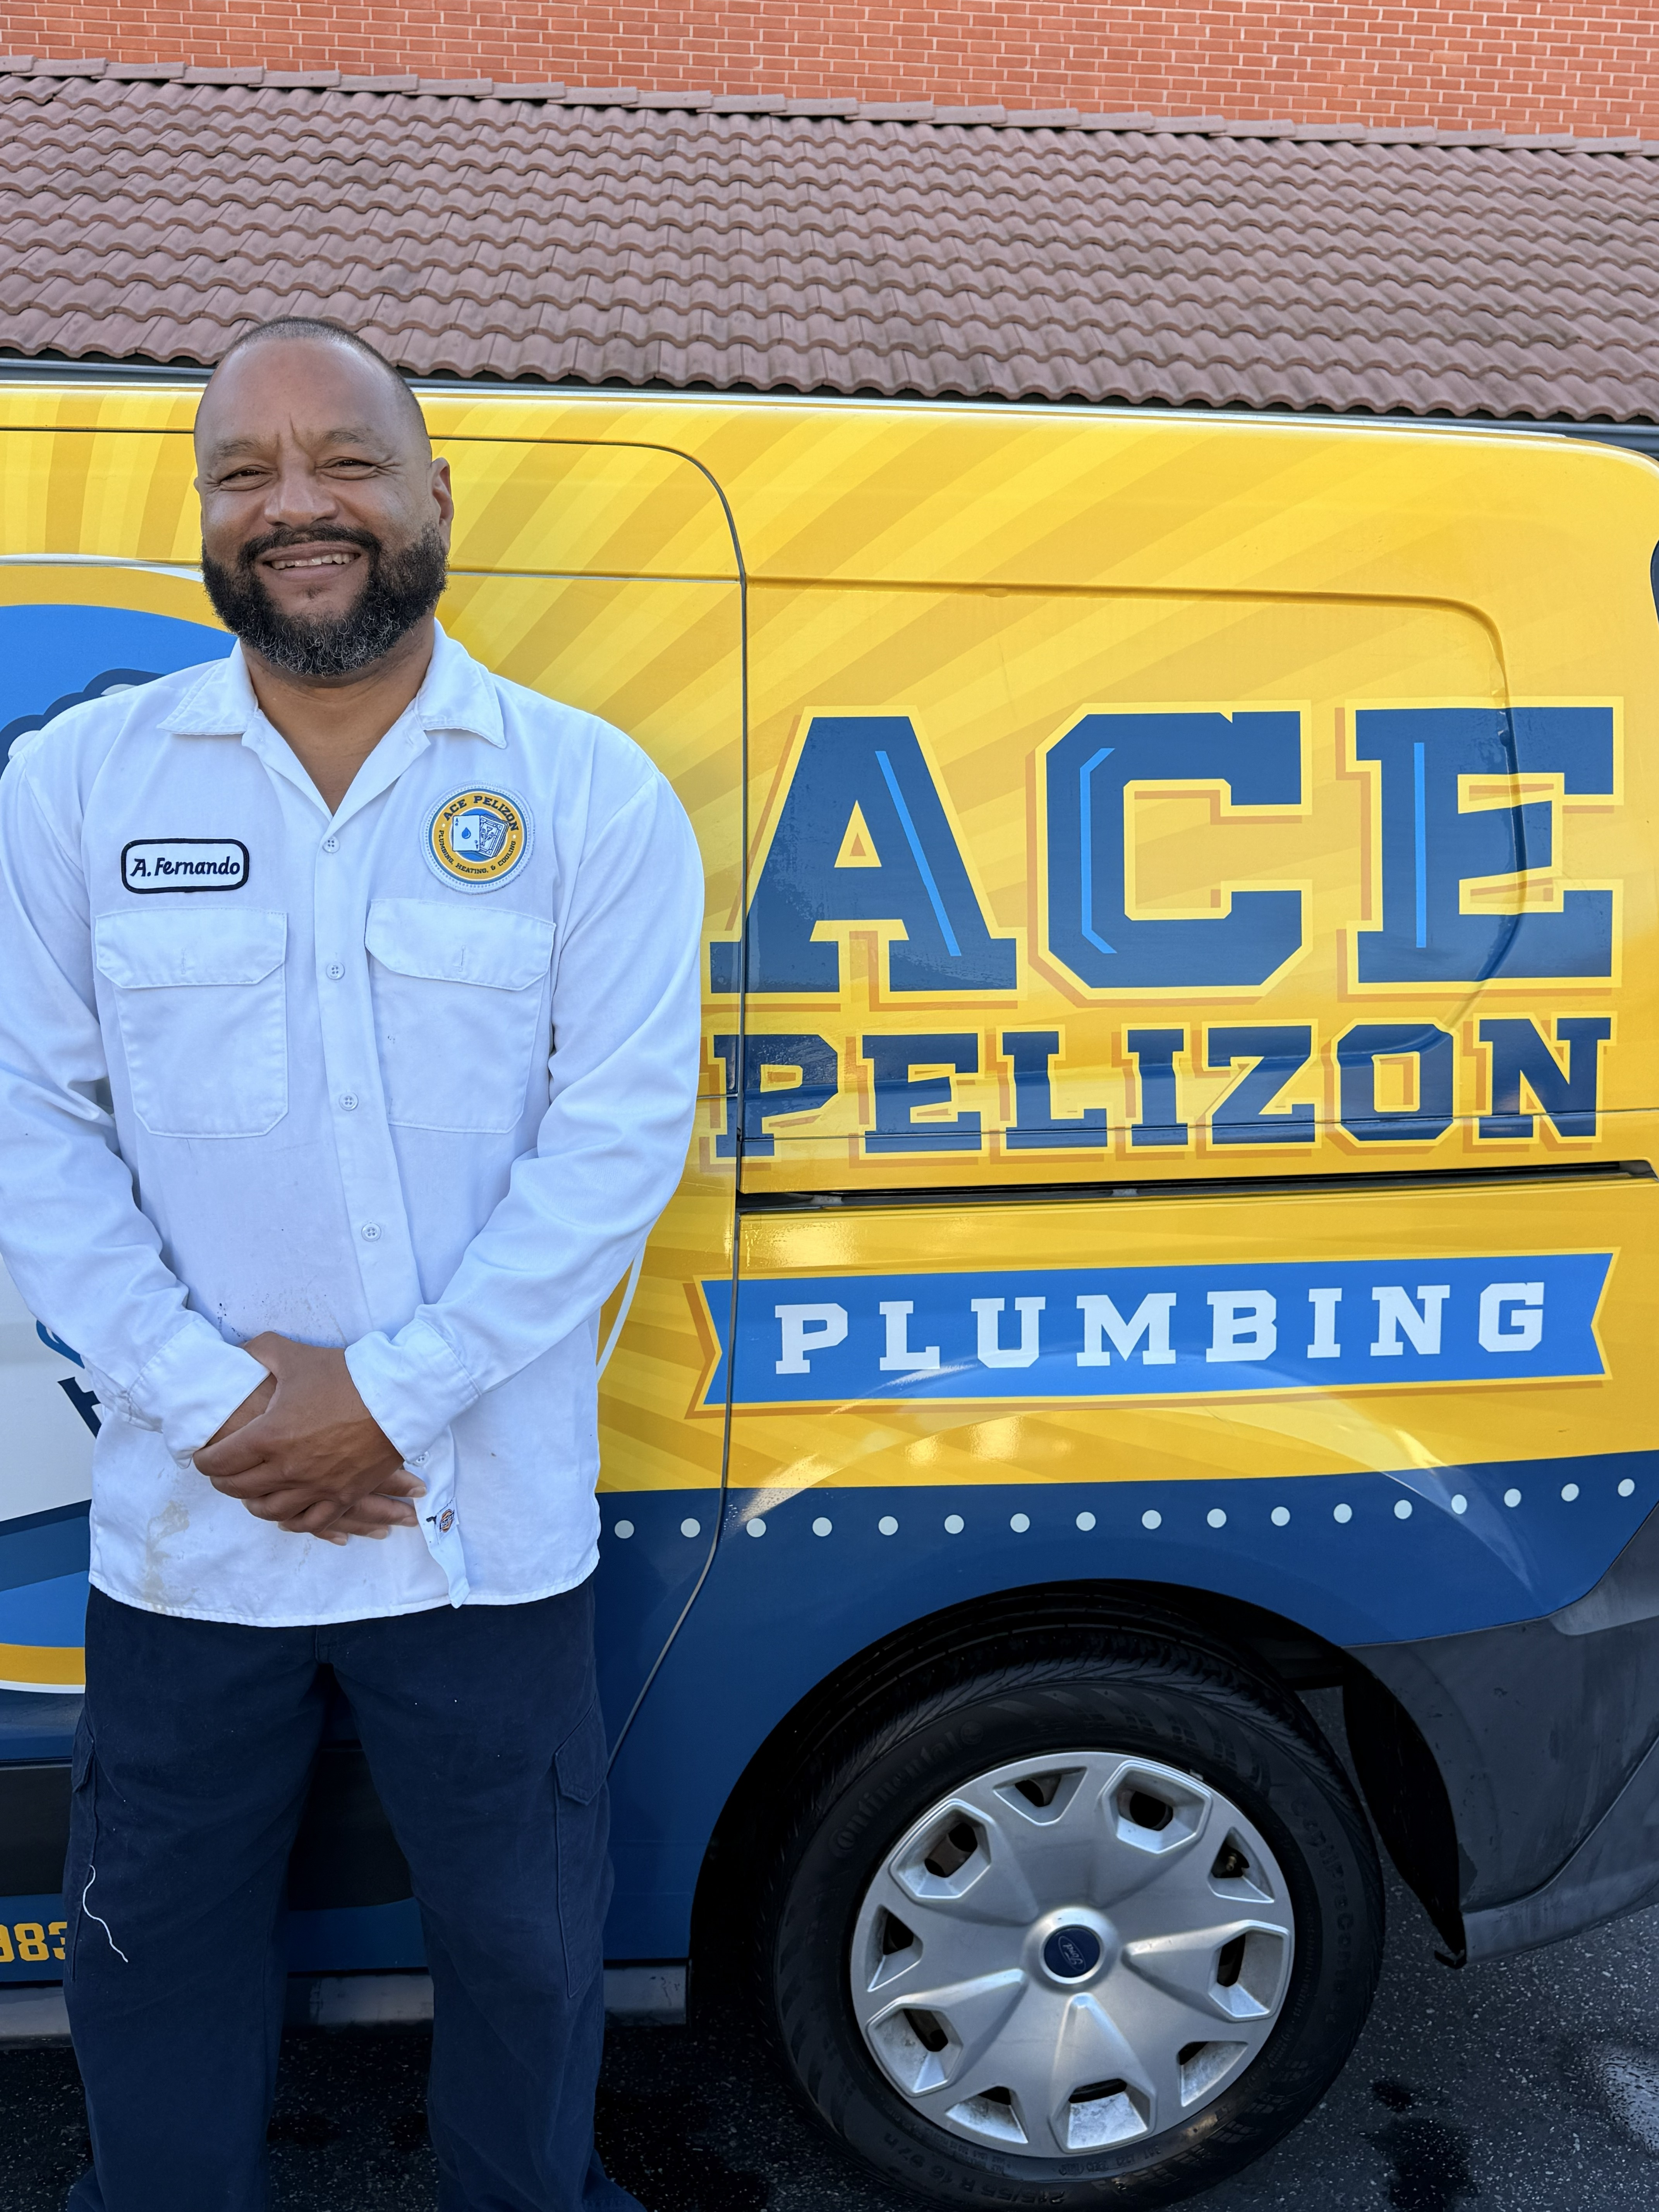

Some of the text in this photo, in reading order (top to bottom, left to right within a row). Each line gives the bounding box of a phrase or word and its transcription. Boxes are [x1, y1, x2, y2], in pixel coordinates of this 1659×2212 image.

[443, 796, 519, 831] ACE PELIZON
[498, 841, 516, 866] COOLING
[710, 707, 1613, 993] ACE
[714, 1017, 1611, 1157] PELIZON
[776, 1282, 1544, 1374] PLUMBING
[1063, 1942, 1083, 1965] Ford
